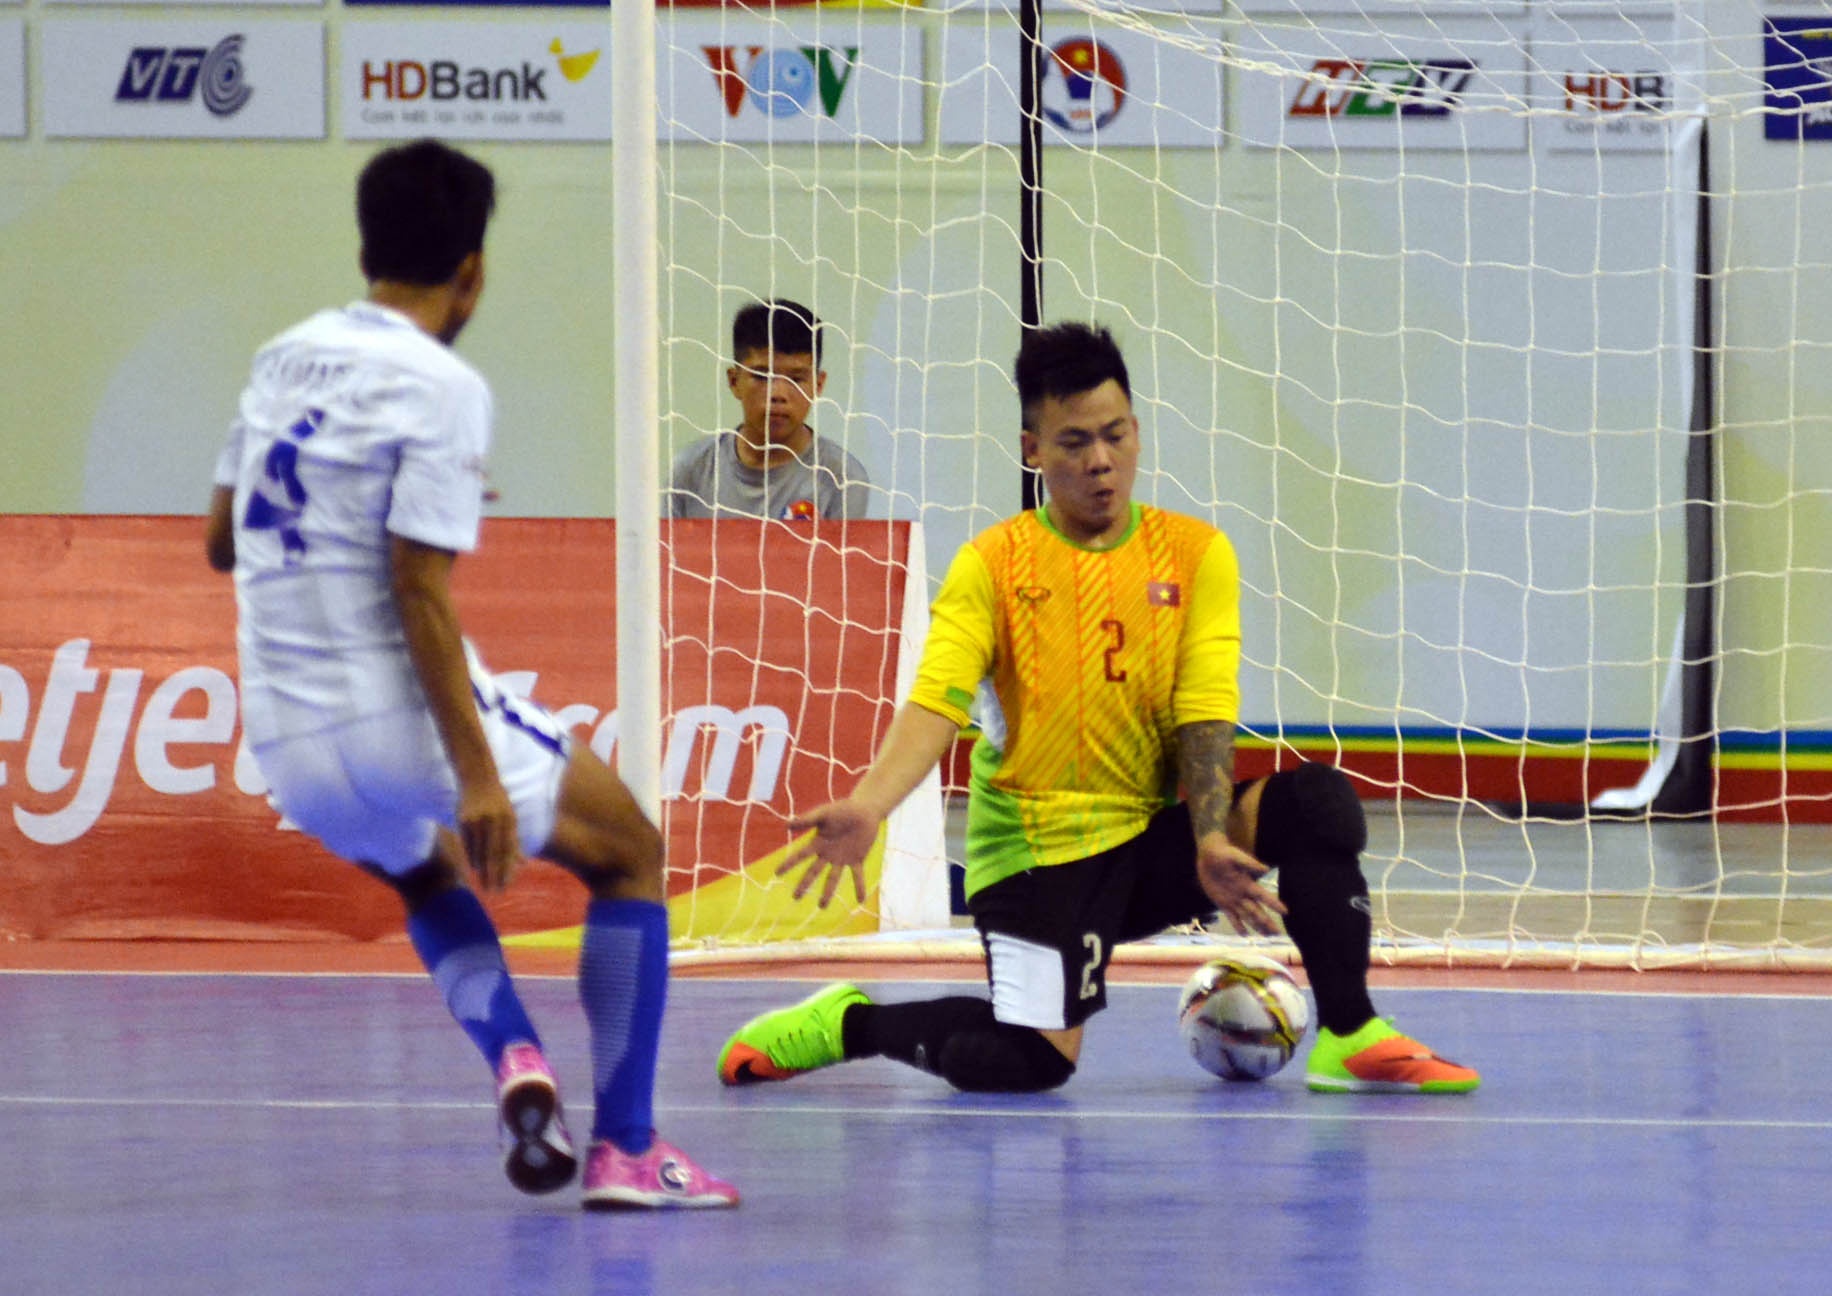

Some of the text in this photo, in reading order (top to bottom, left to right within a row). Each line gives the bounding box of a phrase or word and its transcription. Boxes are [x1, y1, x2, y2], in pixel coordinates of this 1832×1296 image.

[361, 60, 547, 101] HDBank
[1101, 619, 1127, 682] 2
[1079, 932, 1102, 1000] 2
